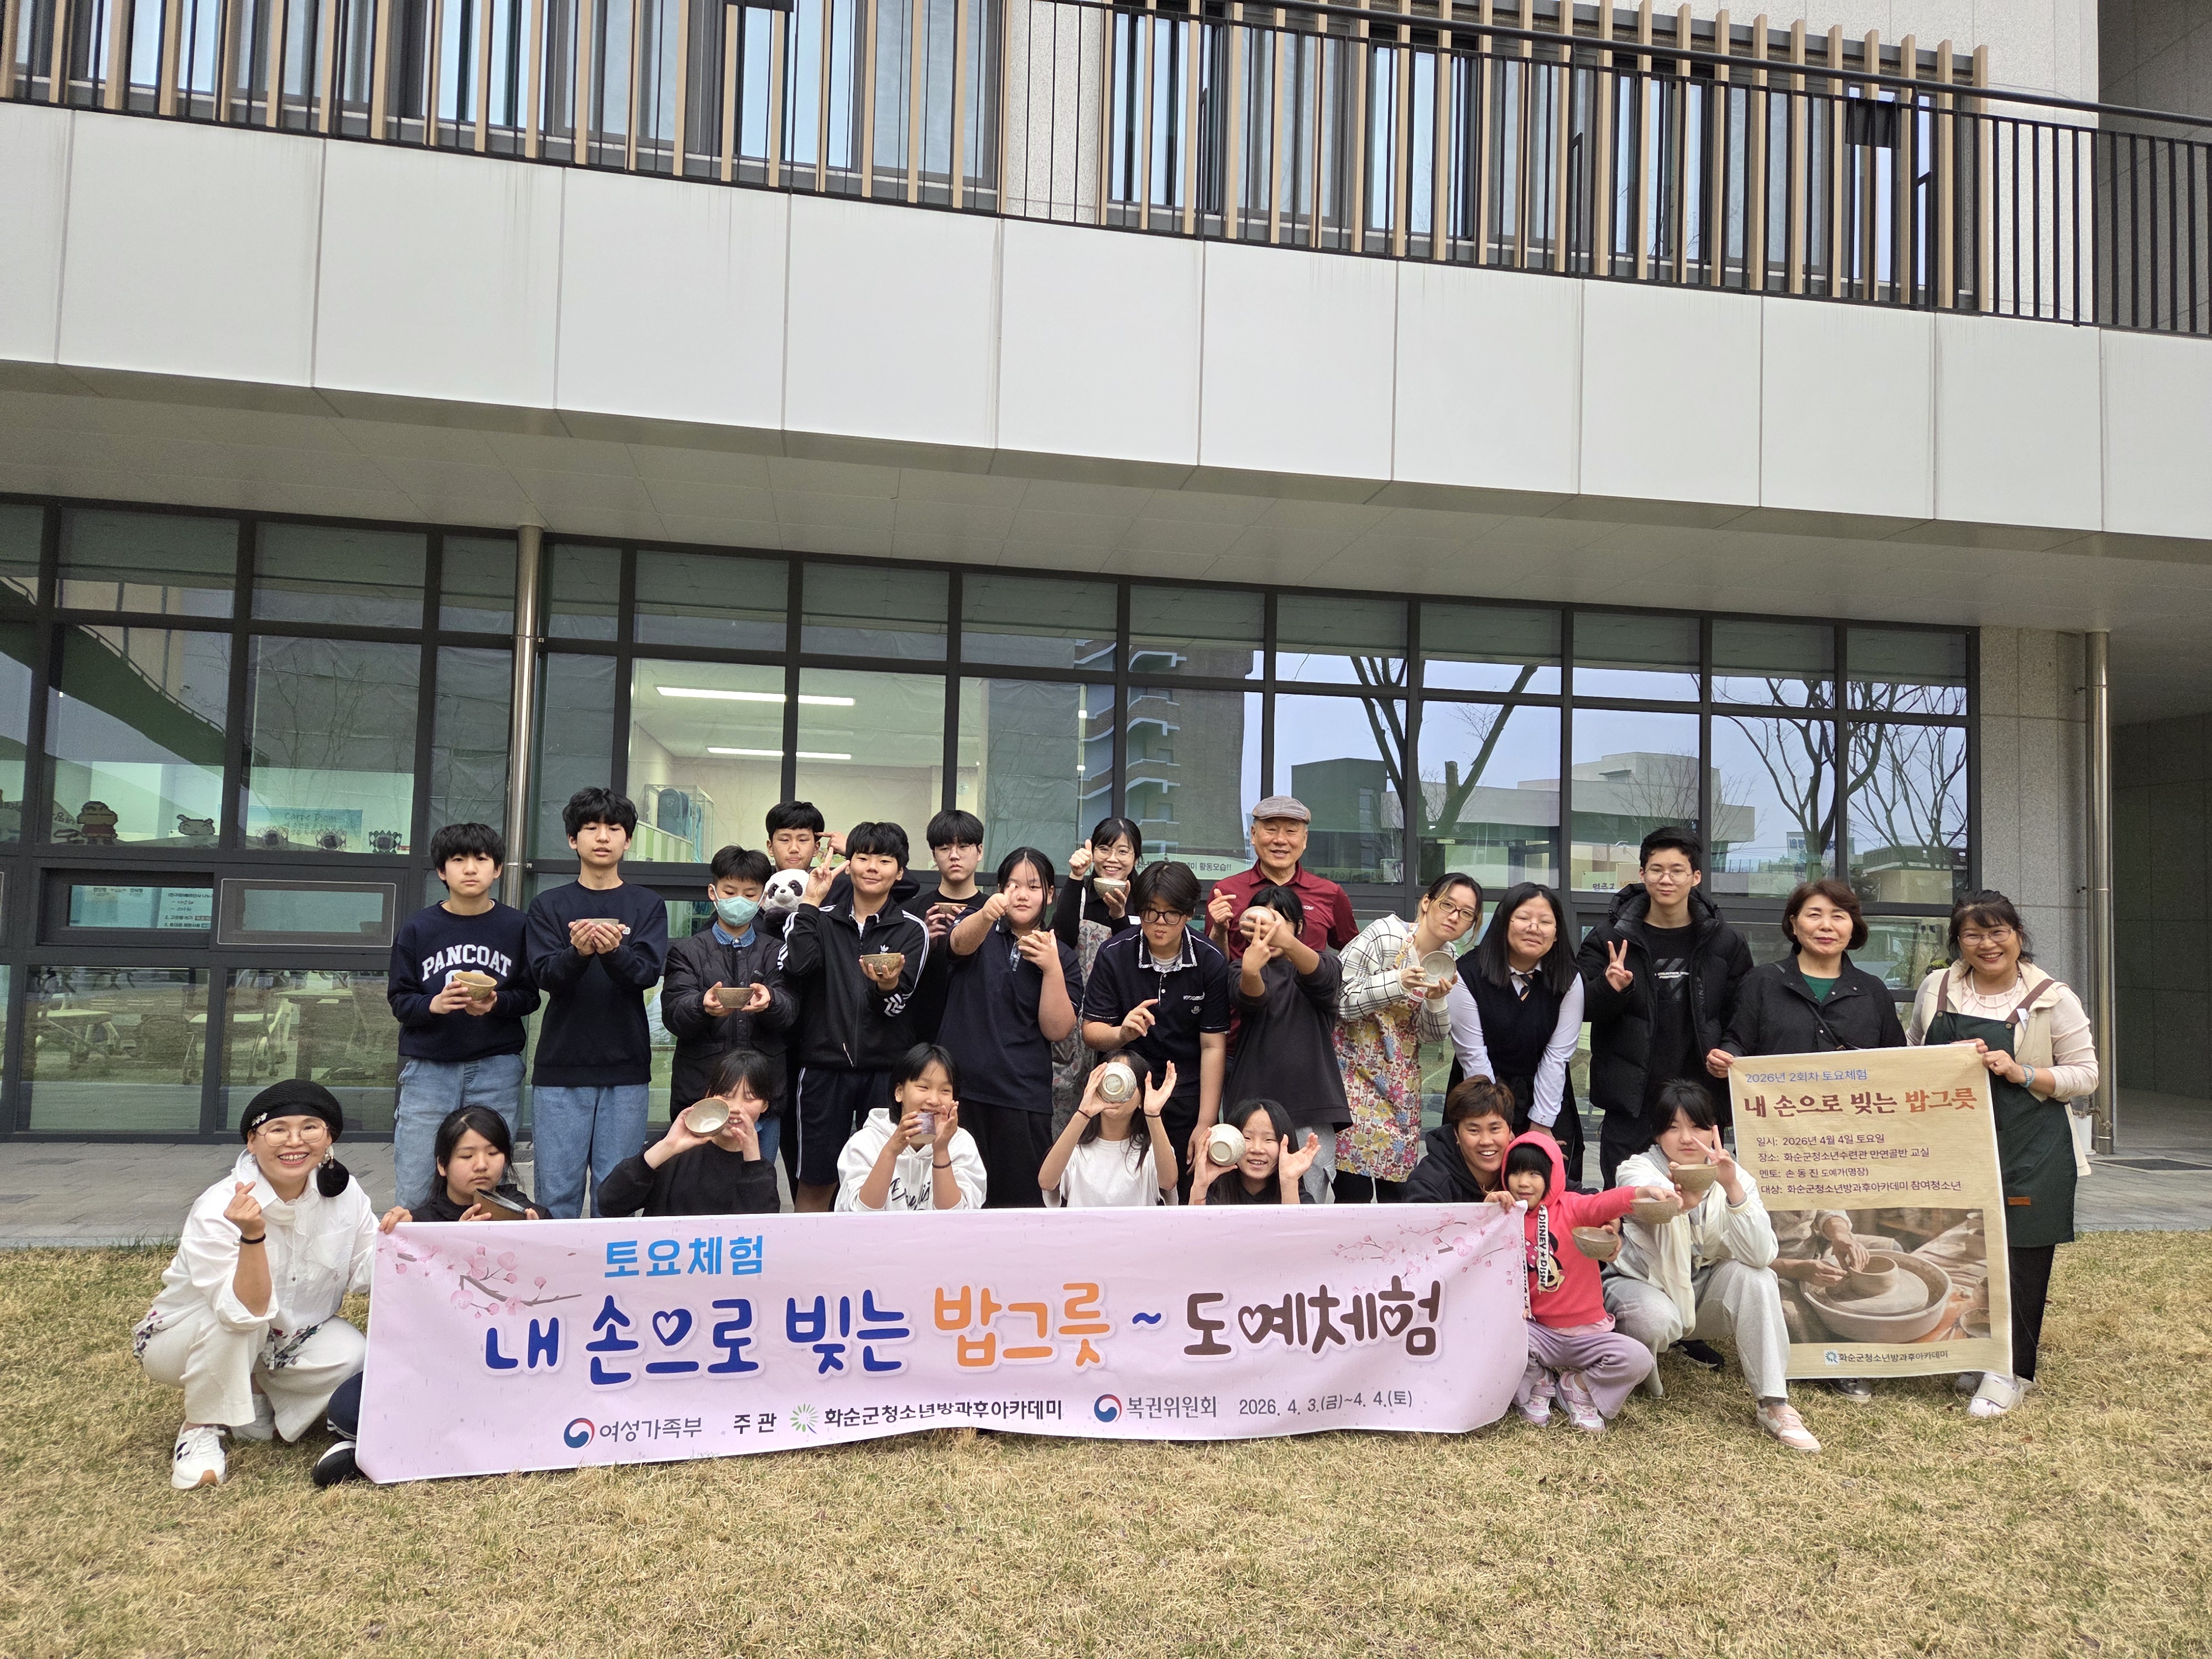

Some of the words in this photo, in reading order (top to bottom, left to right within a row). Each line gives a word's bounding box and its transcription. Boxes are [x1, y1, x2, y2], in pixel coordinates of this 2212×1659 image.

[1199, 862, 1232, 872] 활동모습!!
[422, 944, 512, 982] PANCOAT
[1746, 1072, 1786, 1083] 2026년
[1789, 1071, 1819, 1082] 2회차
[1822, 1069, 1867, 1081] 토요체험
[1744, 1095, 1766, 1118] 내
[1773, 1094, 1843, 1117] 손으로
[1850, 1091, 1897, 1114] 빚는
[1905, 1088, 1978, 1113] 밥그릇
[1756, 1137, 1778, 1146] 일시:
[1782, 1136, 1817, 1145] 2026년
[1819, 1135, 1835, 1145] 4월
[1838, 1135, 1854, 1144] 4일
[1856, 1134, 1885, 1143] 토요일
[1758, 1153, 1779, 1162] 장소:
[1783, 1150, 1867, 1161] 화순군청소년수련관
[1911, 1147, 1929, 1157] 교실
[1759, 1169, 1781, 1178] 멘토:
[1821, 1167, 1869, 1177] 도예가(명장)
[1761, 1185, 1782, 1194] 대상:
[1787, 1181, 1908, 1193] 화순군청소년방과후아카데미
[1911, 1180, 1961, 1191] 참여청소년
[604, 1235, 764, 1279] 토요체험
[486, 1317, 559, 1370] 내
[586, 1295, 759, 1386] 손으로
[786, 1289, 910, 1375] 빚는
[935, 1282, 1111, 1368] 밥그릇
[1184, 1274, 1441, 1357] 도예체험
[1838, 1350, 1949, 1363] 화순군청소년방과후아카데미
[600, 1417, 702, 1443] 여성가족부
[825, 1400, 1062, 1428] 화순군청소년방과후아카데미
[1127, 1396, 1217, 1419] 복권위원회
[1239, 1399, 1281, 1417] 2026.
